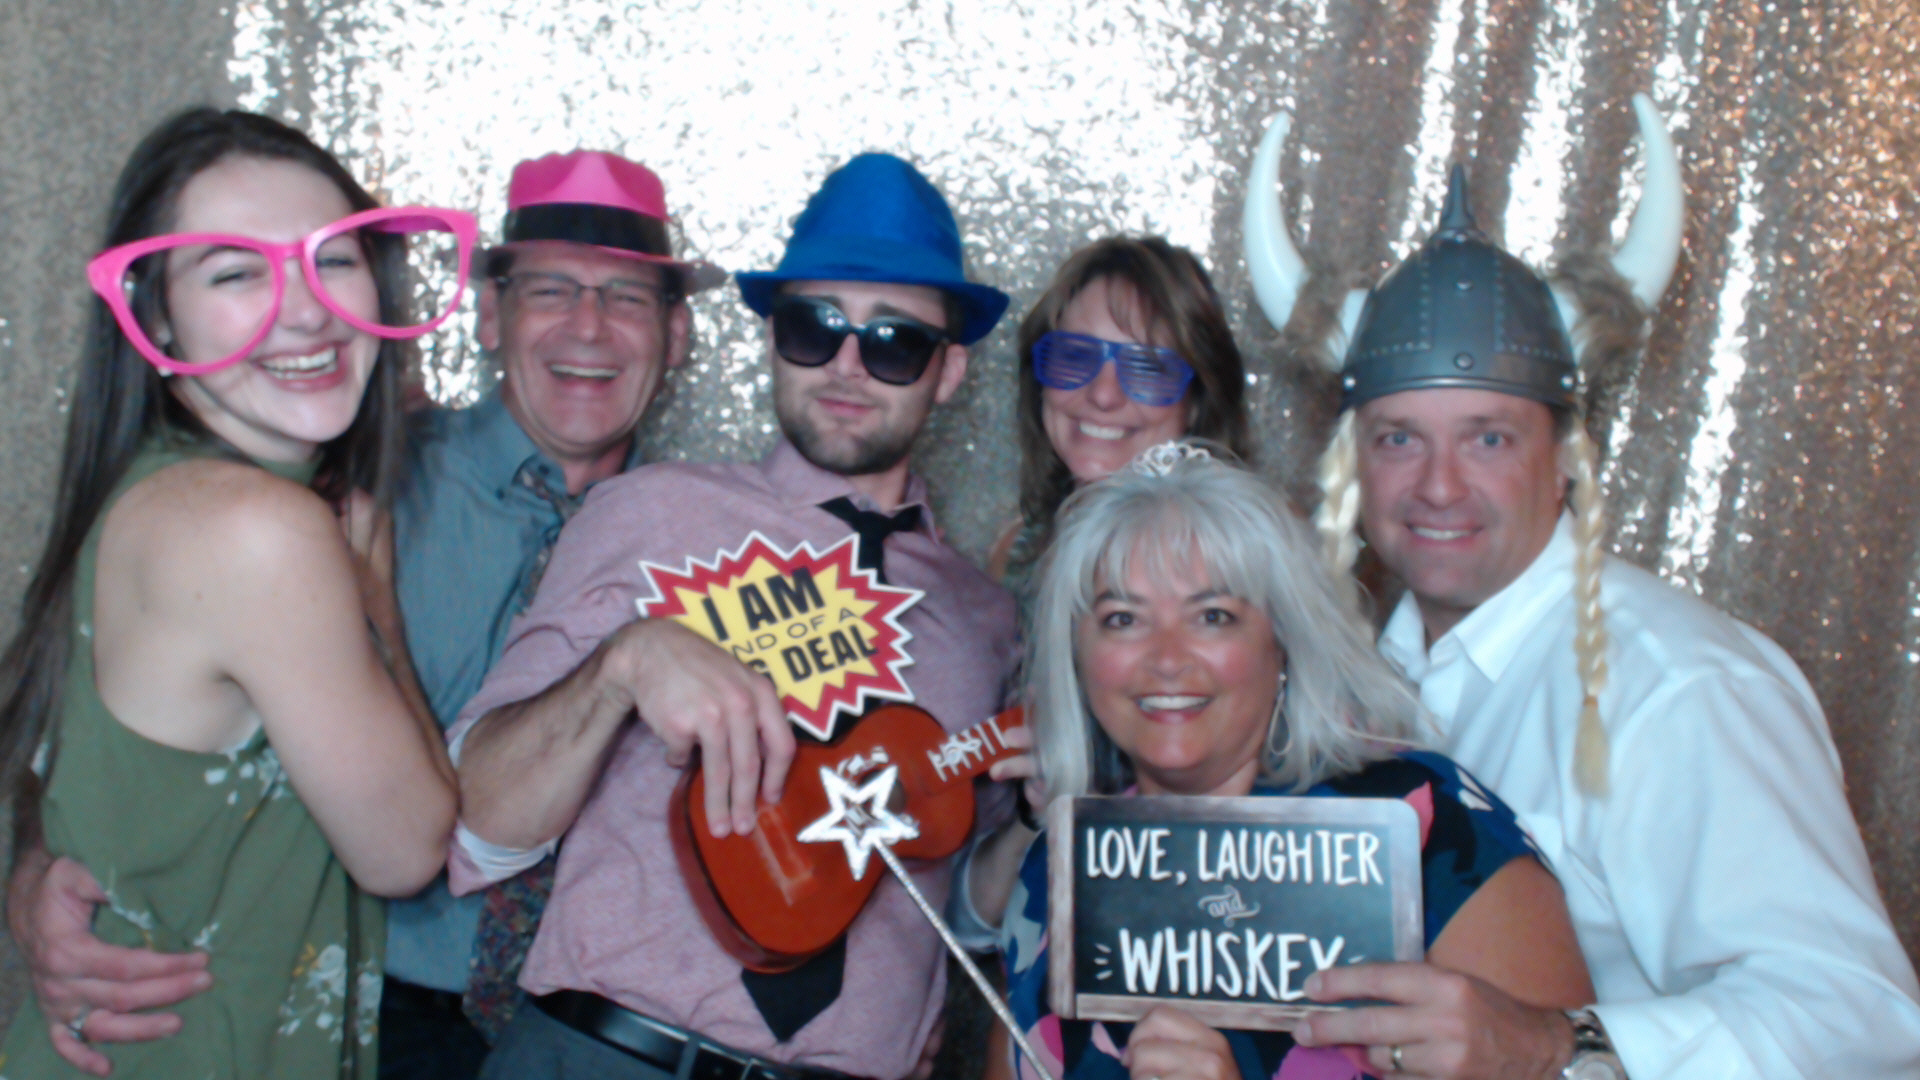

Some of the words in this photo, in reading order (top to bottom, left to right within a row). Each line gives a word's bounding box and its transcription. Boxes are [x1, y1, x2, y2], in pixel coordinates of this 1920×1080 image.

[701, 597, 730, 642] I
[737, 566, 825, 631] AM
[731, 633, 777, 659] ND
[787, 615, 825, 639] OF
[839, 608, 857, 623] A
[780, 625, 878, 683] DEAL
[1086, 827, 1187, 885] LOVE,
[1197, 829, 1383, 886] LAUGHTER
[1198, 885, 1260, 927] and
[1119, 927, 1345, 1001] WHISKEY
